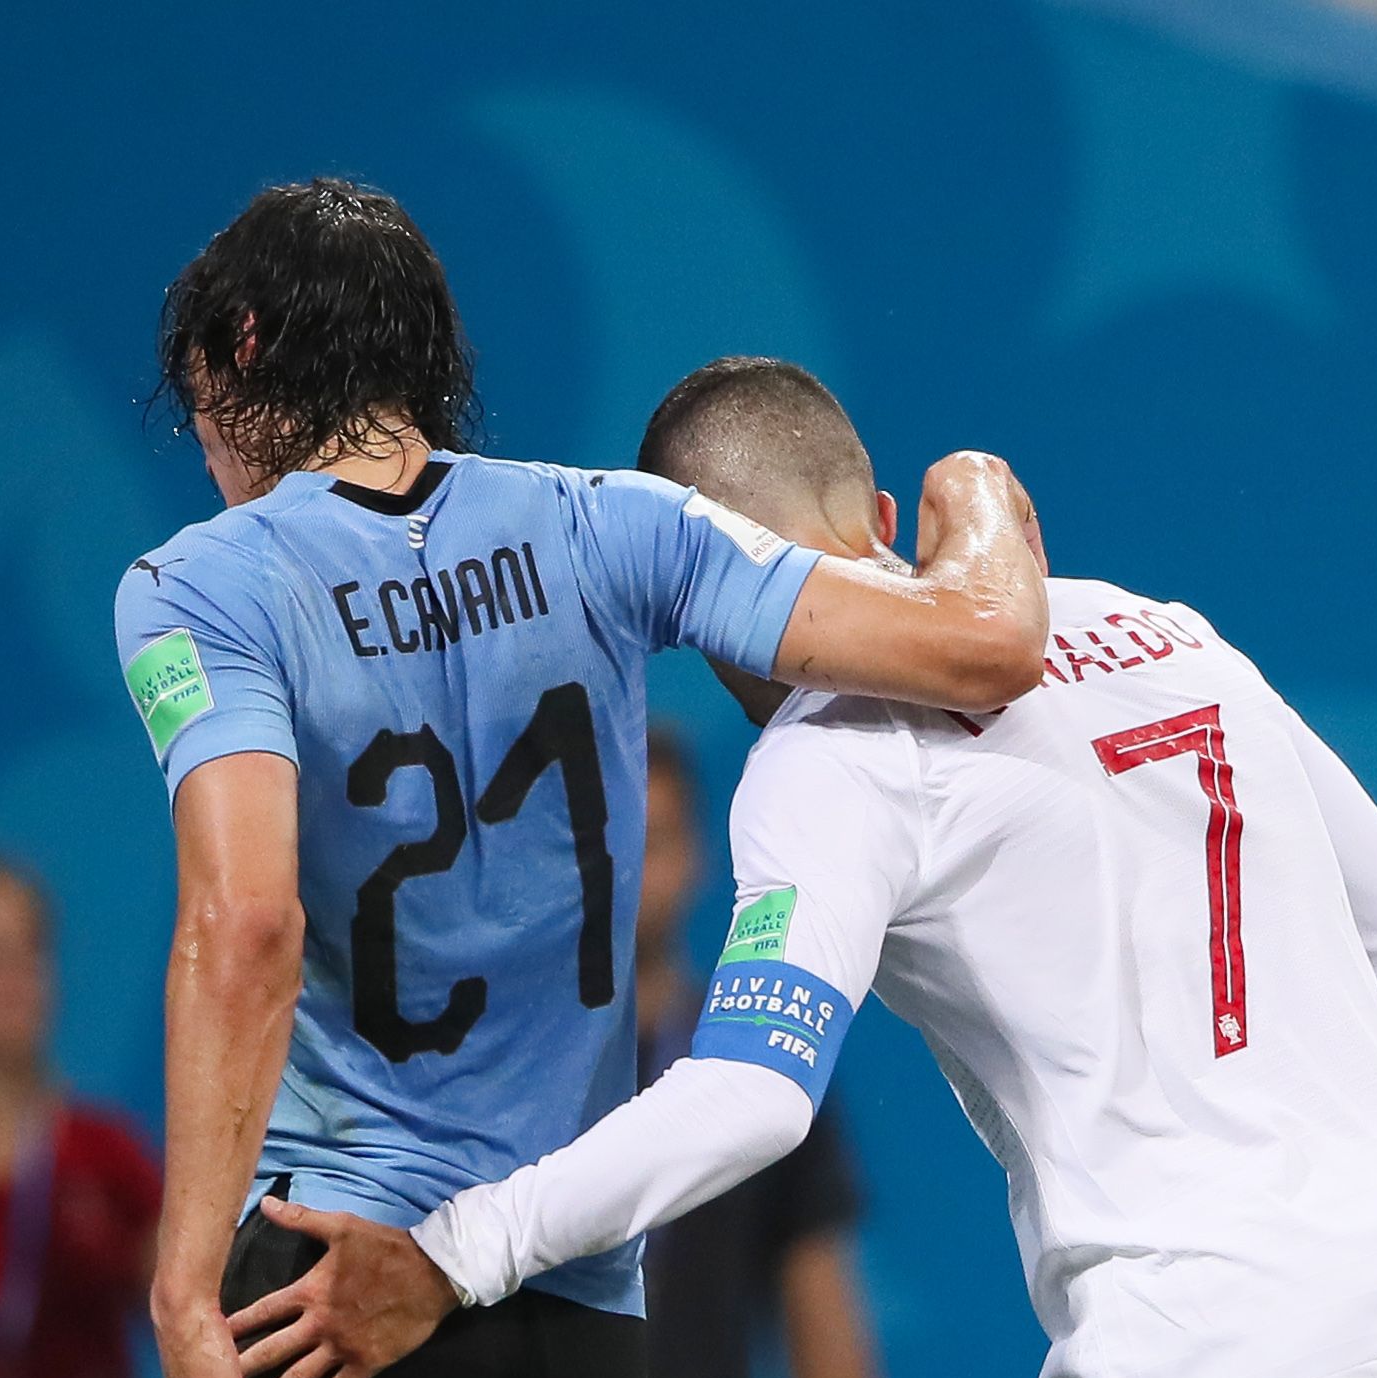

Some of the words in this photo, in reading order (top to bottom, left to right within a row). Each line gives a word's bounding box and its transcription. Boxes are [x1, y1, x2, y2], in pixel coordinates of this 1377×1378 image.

[333, 542, 549, 657] E.CAVANI
[173, 684, 200, 703] FIFA
[347, 681, 615, 1063] 21
[1091, 703, 1248, 1058] 7
[754, 939, 779, 952] FIFA
[709, 994, 825, 1036] FOOTBALL
[714, 977, 834, 1021] LIVING
[767, 1029, 818, 1068] FIFA
